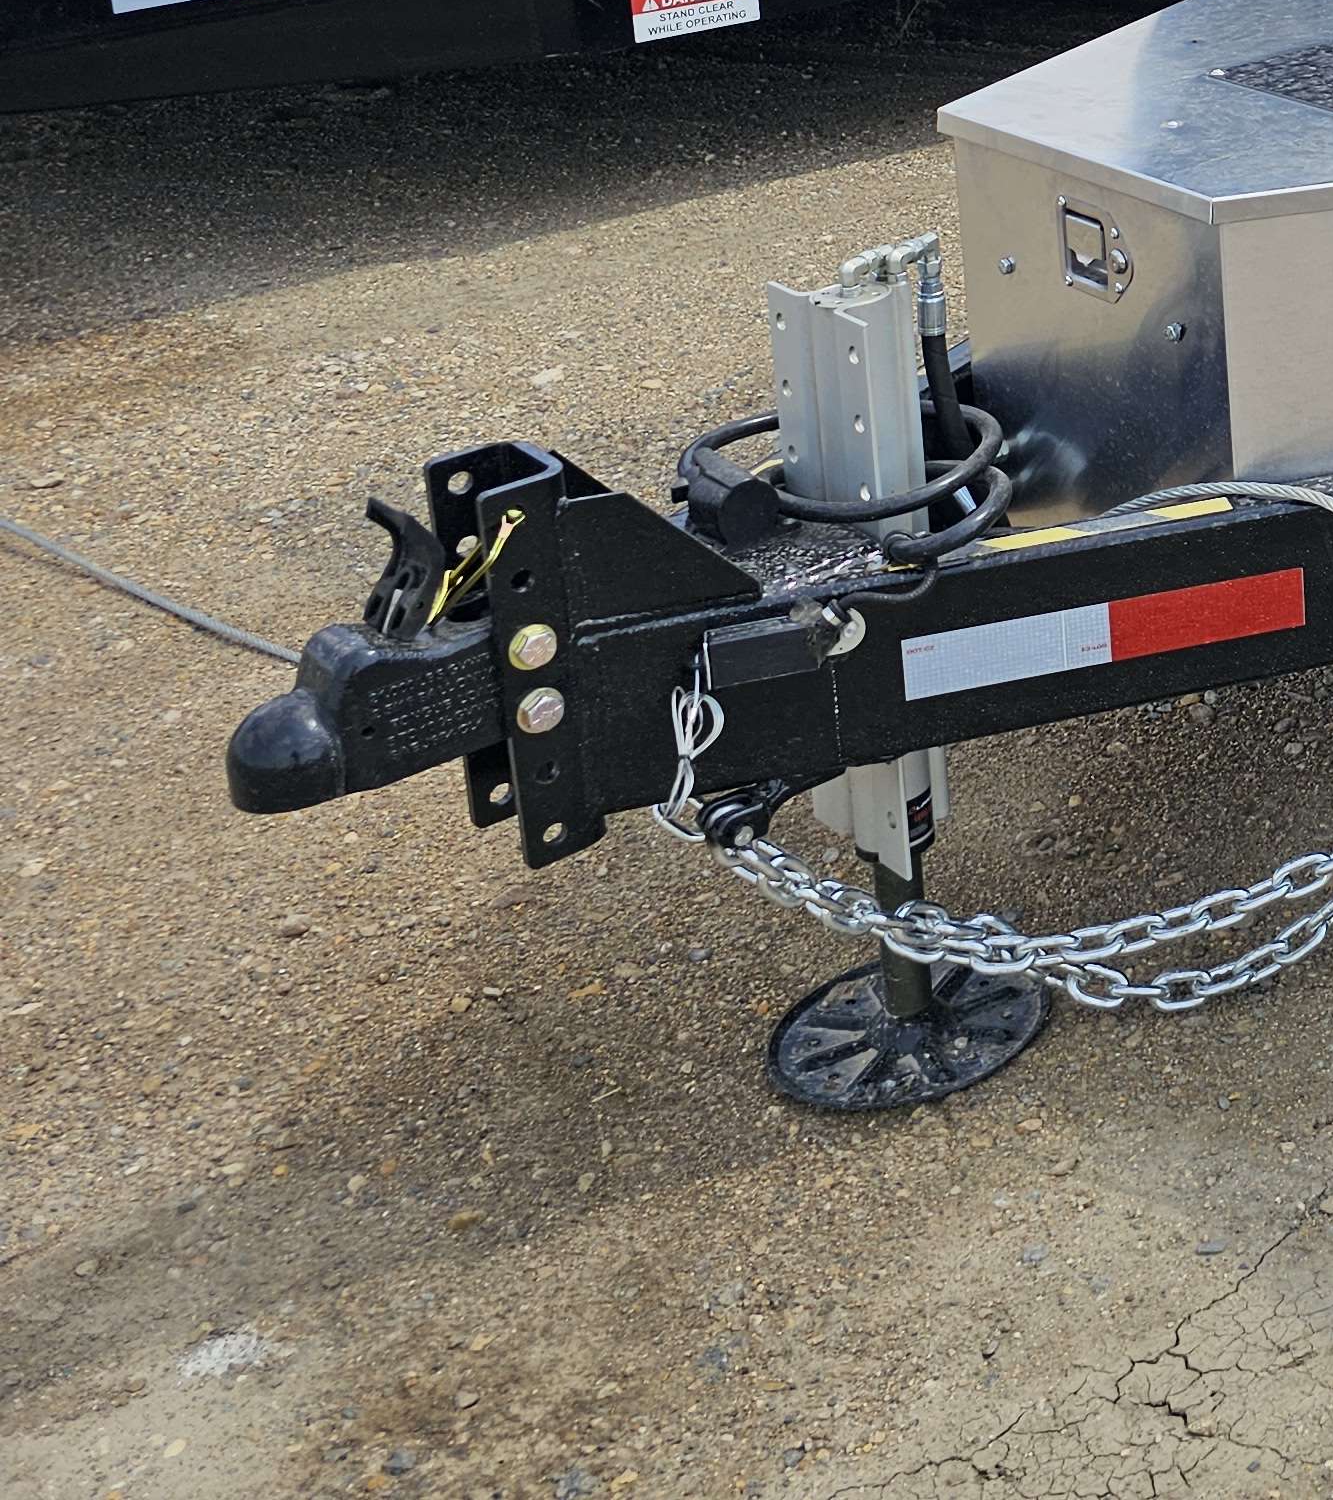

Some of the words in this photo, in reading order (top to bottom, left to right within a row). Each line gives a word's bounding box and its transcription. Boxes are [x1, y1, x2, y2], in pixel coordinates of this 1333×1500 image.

[648, 22, 683, 36] WHILE
[685, 10, 747, 29] OPERATING
[659, 8, 695, 22] STAND
[698, 0, 734, 14] CLEAR
